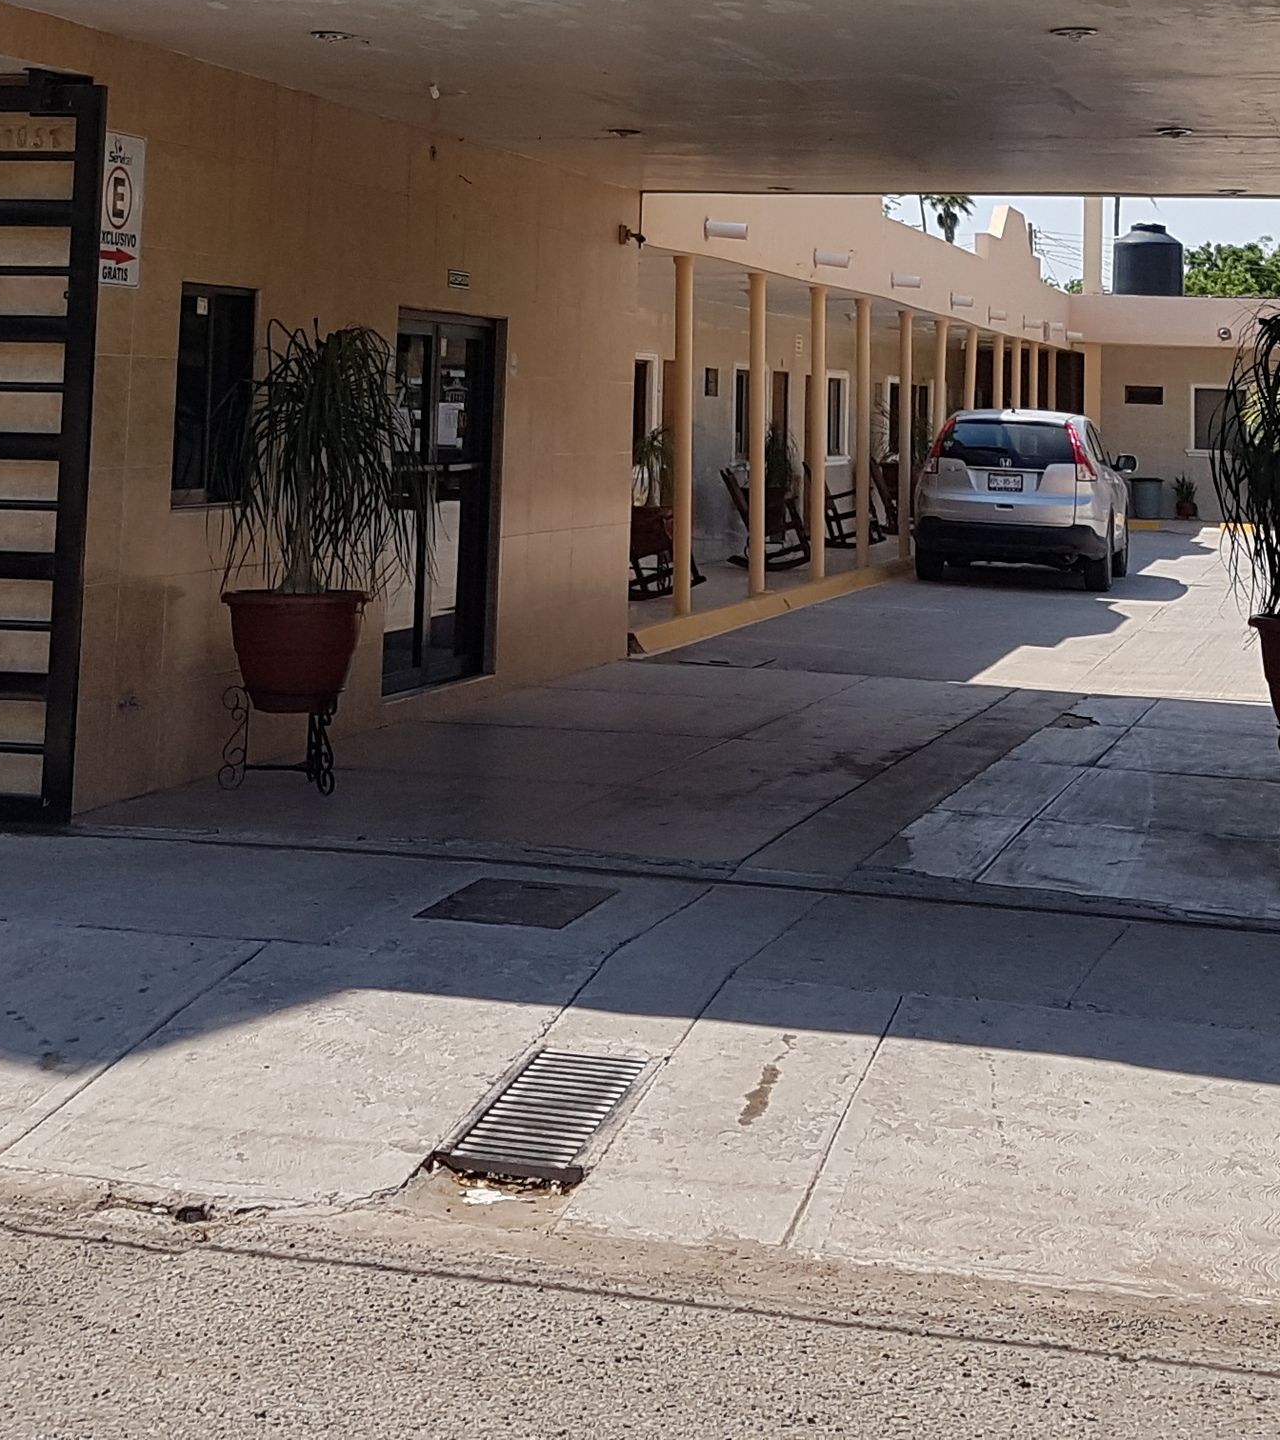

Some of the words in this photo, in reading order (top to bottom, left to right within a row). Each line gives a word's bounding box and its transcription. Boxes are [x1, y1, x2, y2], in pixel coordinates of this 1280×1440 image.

[112, 176, 126, 220] E
[100, 229, 138, 249] XCLUSIVO
[102, 265, 129, 283] GRATIS
